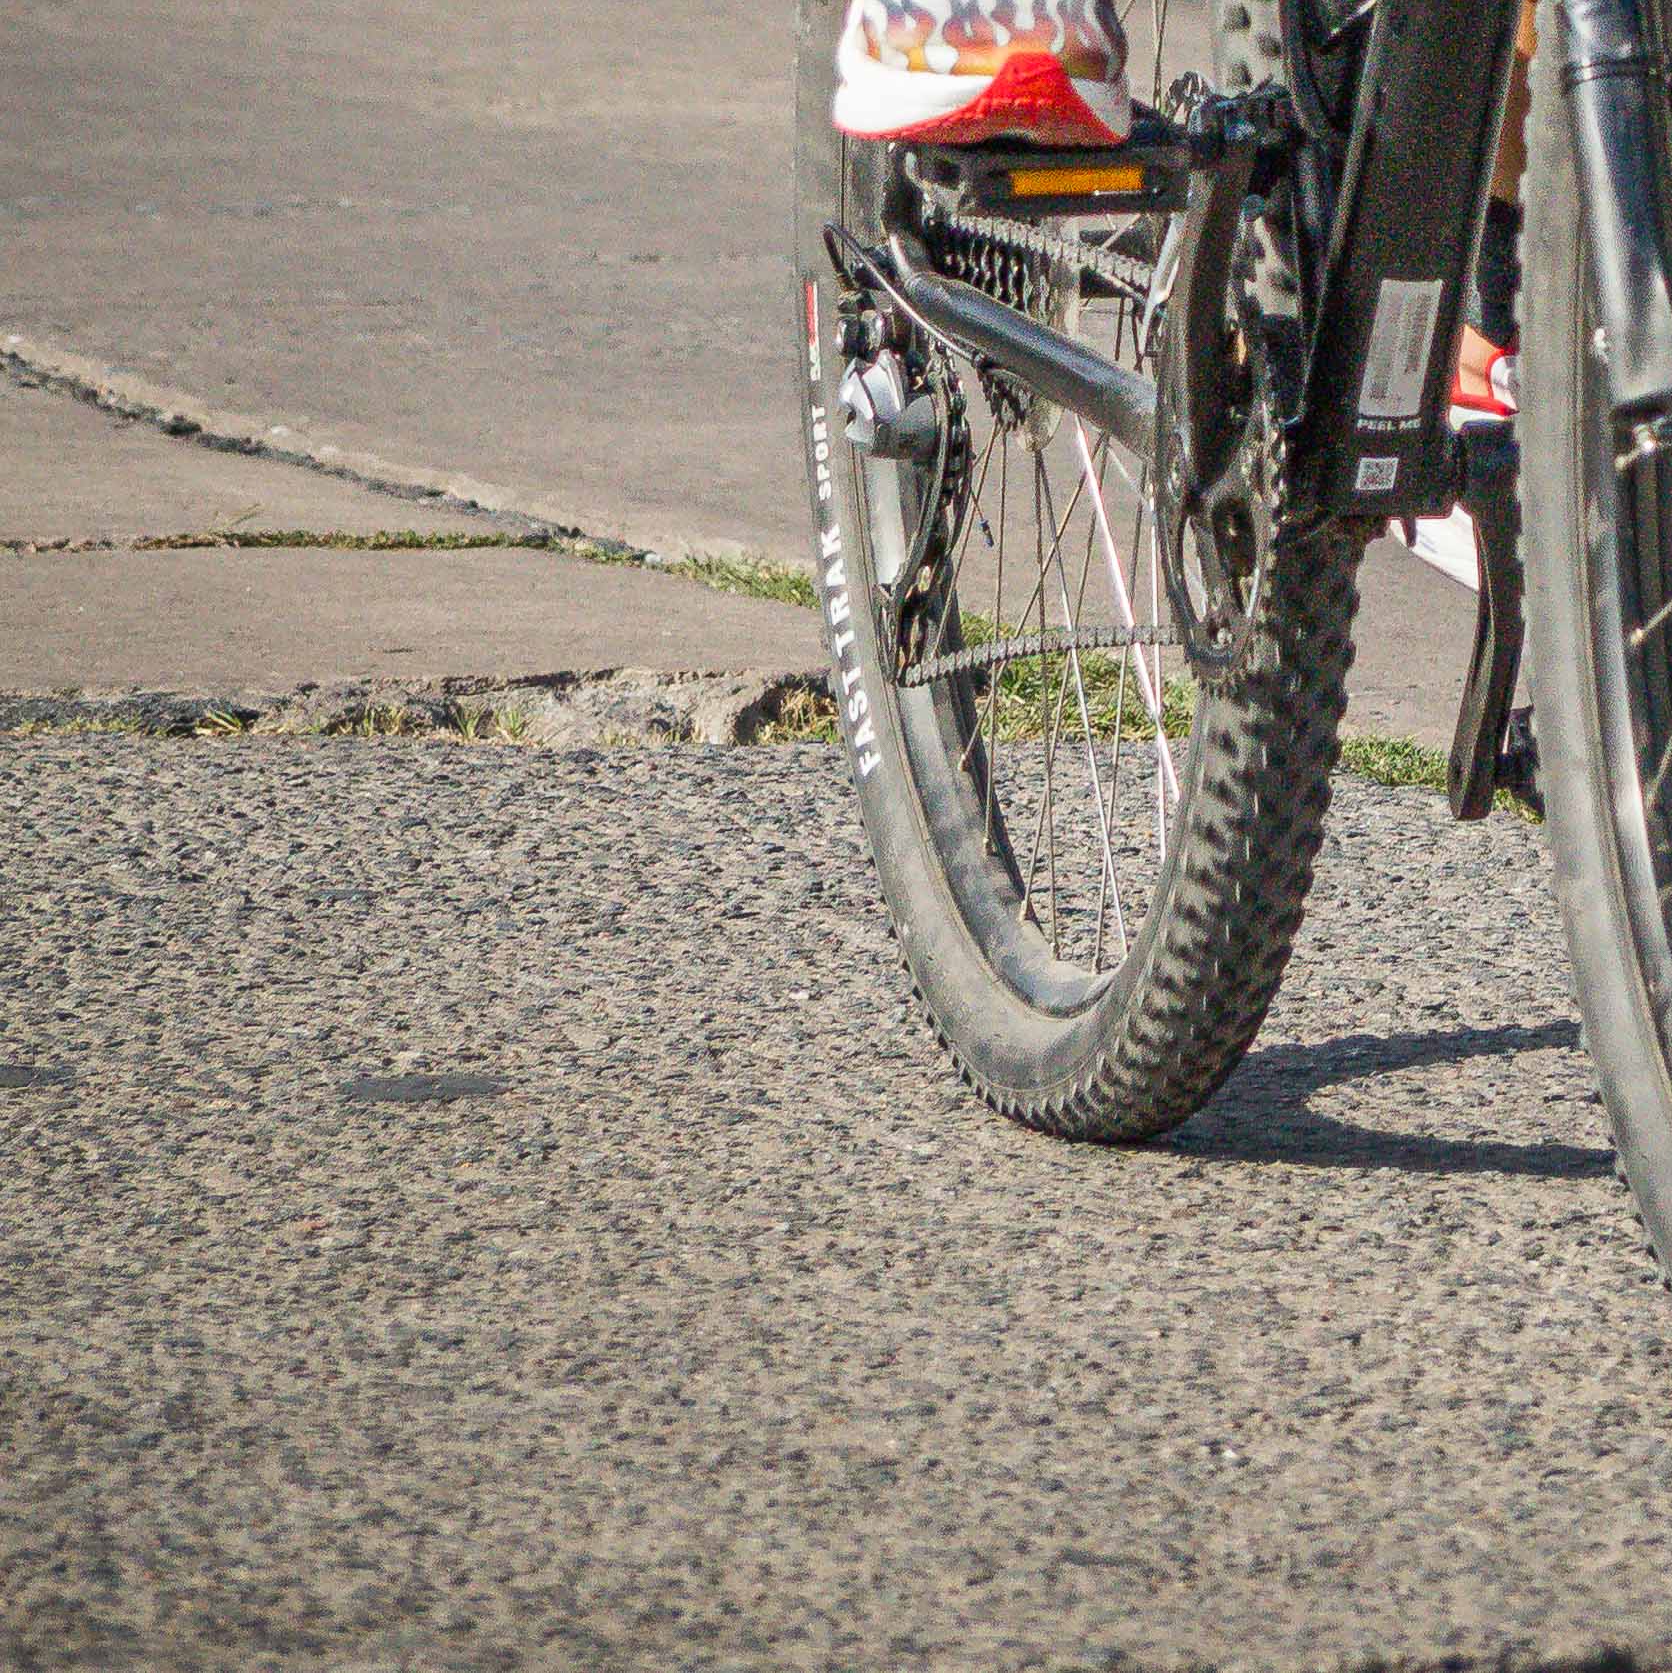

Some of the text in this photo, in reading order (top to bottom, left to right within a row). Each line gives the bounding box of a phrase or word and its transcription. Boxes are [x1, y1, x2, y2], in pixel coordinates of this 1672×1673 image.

[811, 405, 833, 502] SPORT
[820, 522, 856, 658] TRAK
[843, 665, 882, 777] FAST
